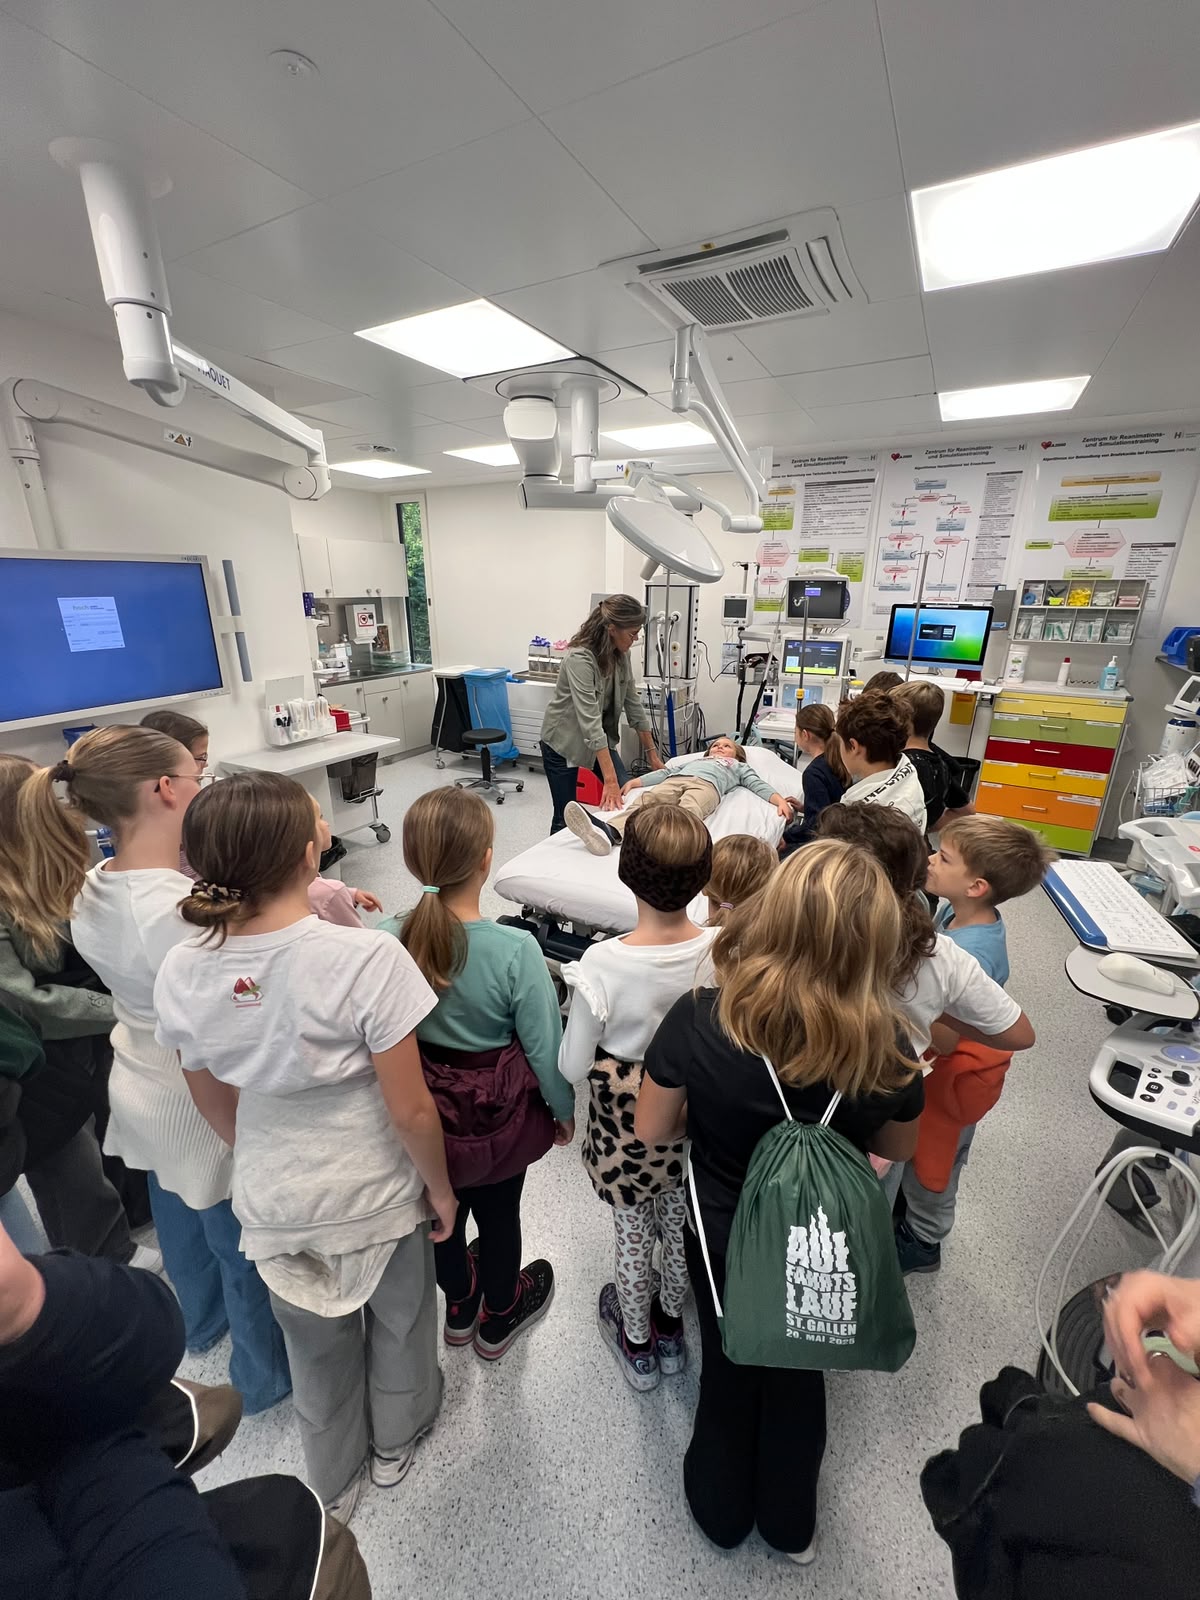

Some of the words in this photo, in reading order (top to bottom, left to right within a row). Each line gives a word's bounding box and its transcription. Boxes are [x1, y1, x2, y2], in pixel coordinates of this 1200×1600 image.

[198, 368, 230, 391] AQUET
[1119, 432, 1165, 440] Reanimations-
[1098, 438, 1159, 447] Simulationstraining
[939, 450, 989, 459] Simulationstraining
[785, 1261, 857, 1292] FAHRTS
[785, 1281, 858, 1321] LAUF
[805, 1333, 826, 1343] MAI
